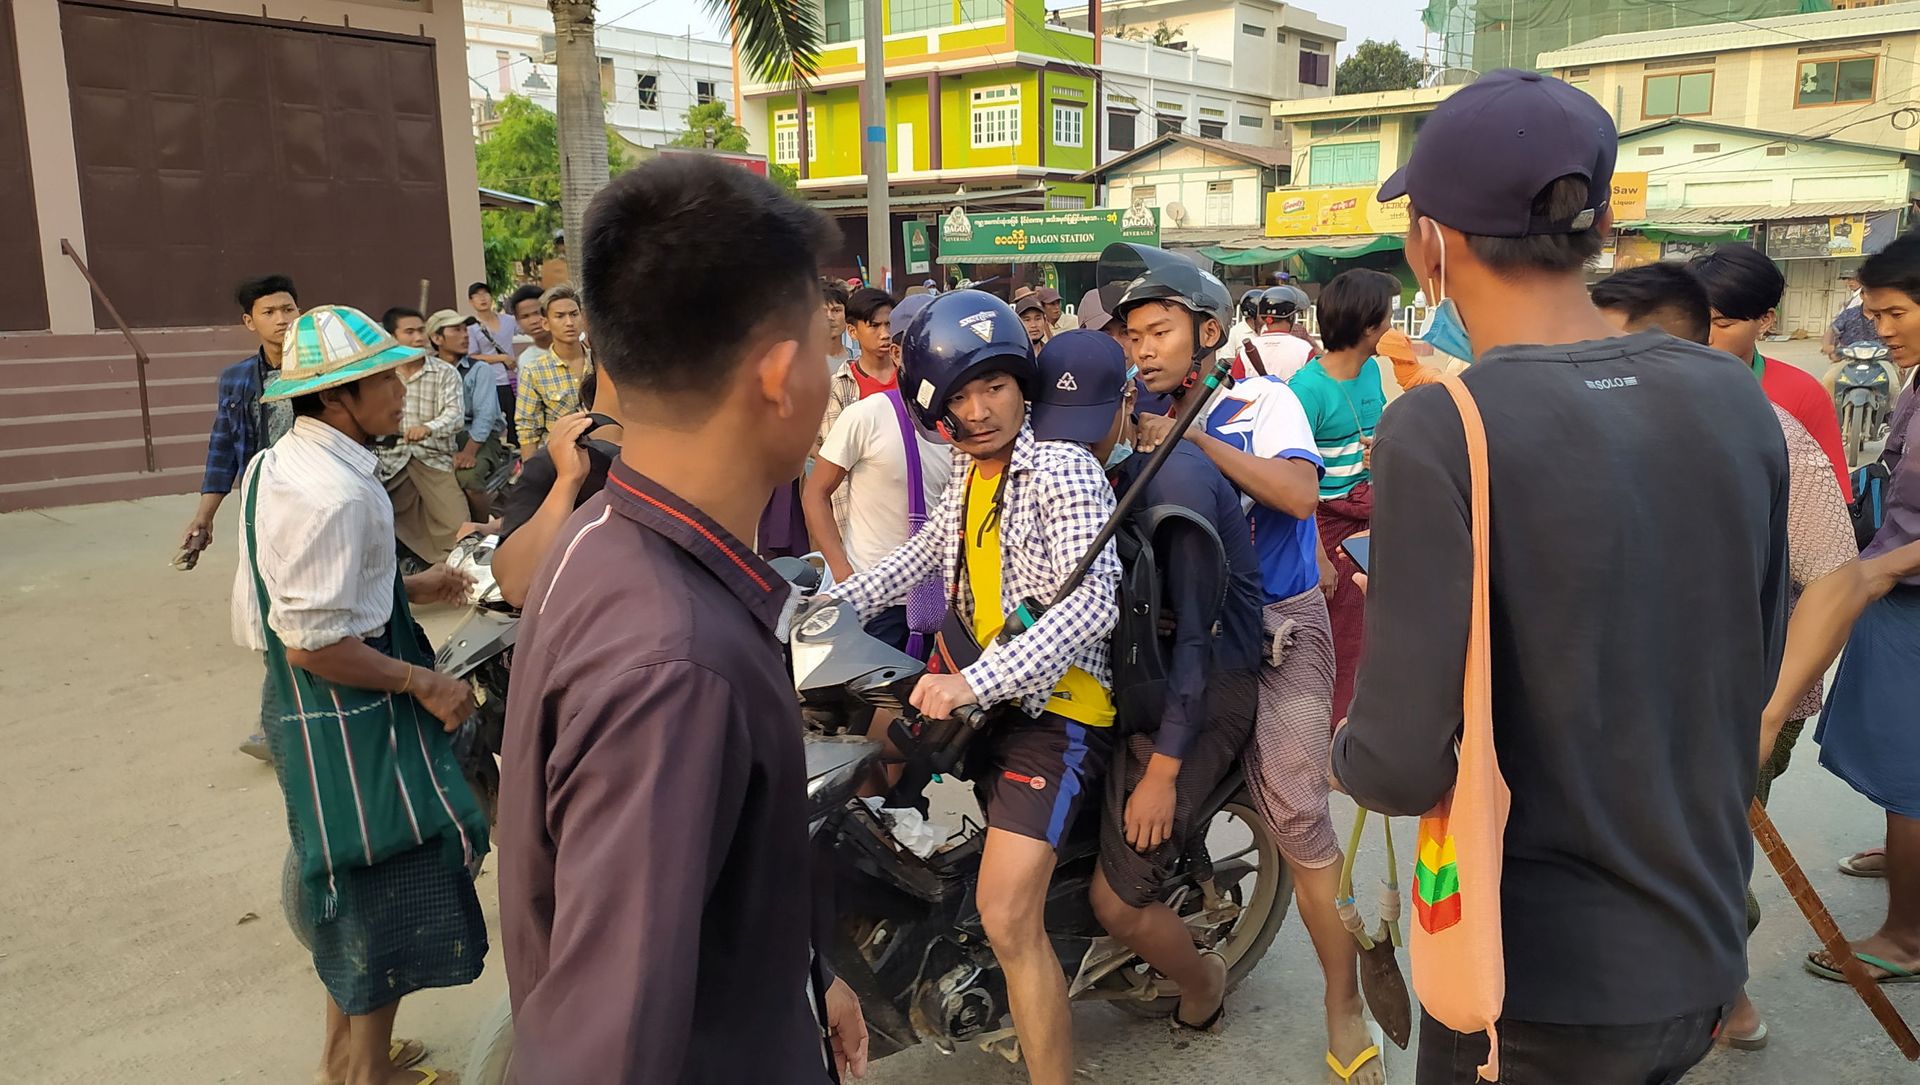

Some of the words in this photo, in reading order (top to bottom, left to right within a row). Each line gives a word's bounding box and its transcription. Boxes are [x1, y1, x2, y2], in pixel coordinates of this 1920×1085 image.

[1613, 186, 1638, 195] Saw
[1122, 217, 1153, 227] DAGON
[943, 225, 971, 234] DAGON
[1030, 234, 1059, 244] DAGON
[1060, 233, 1095, 243] STATION
[1594, 377, 1624, 390] SOLO
